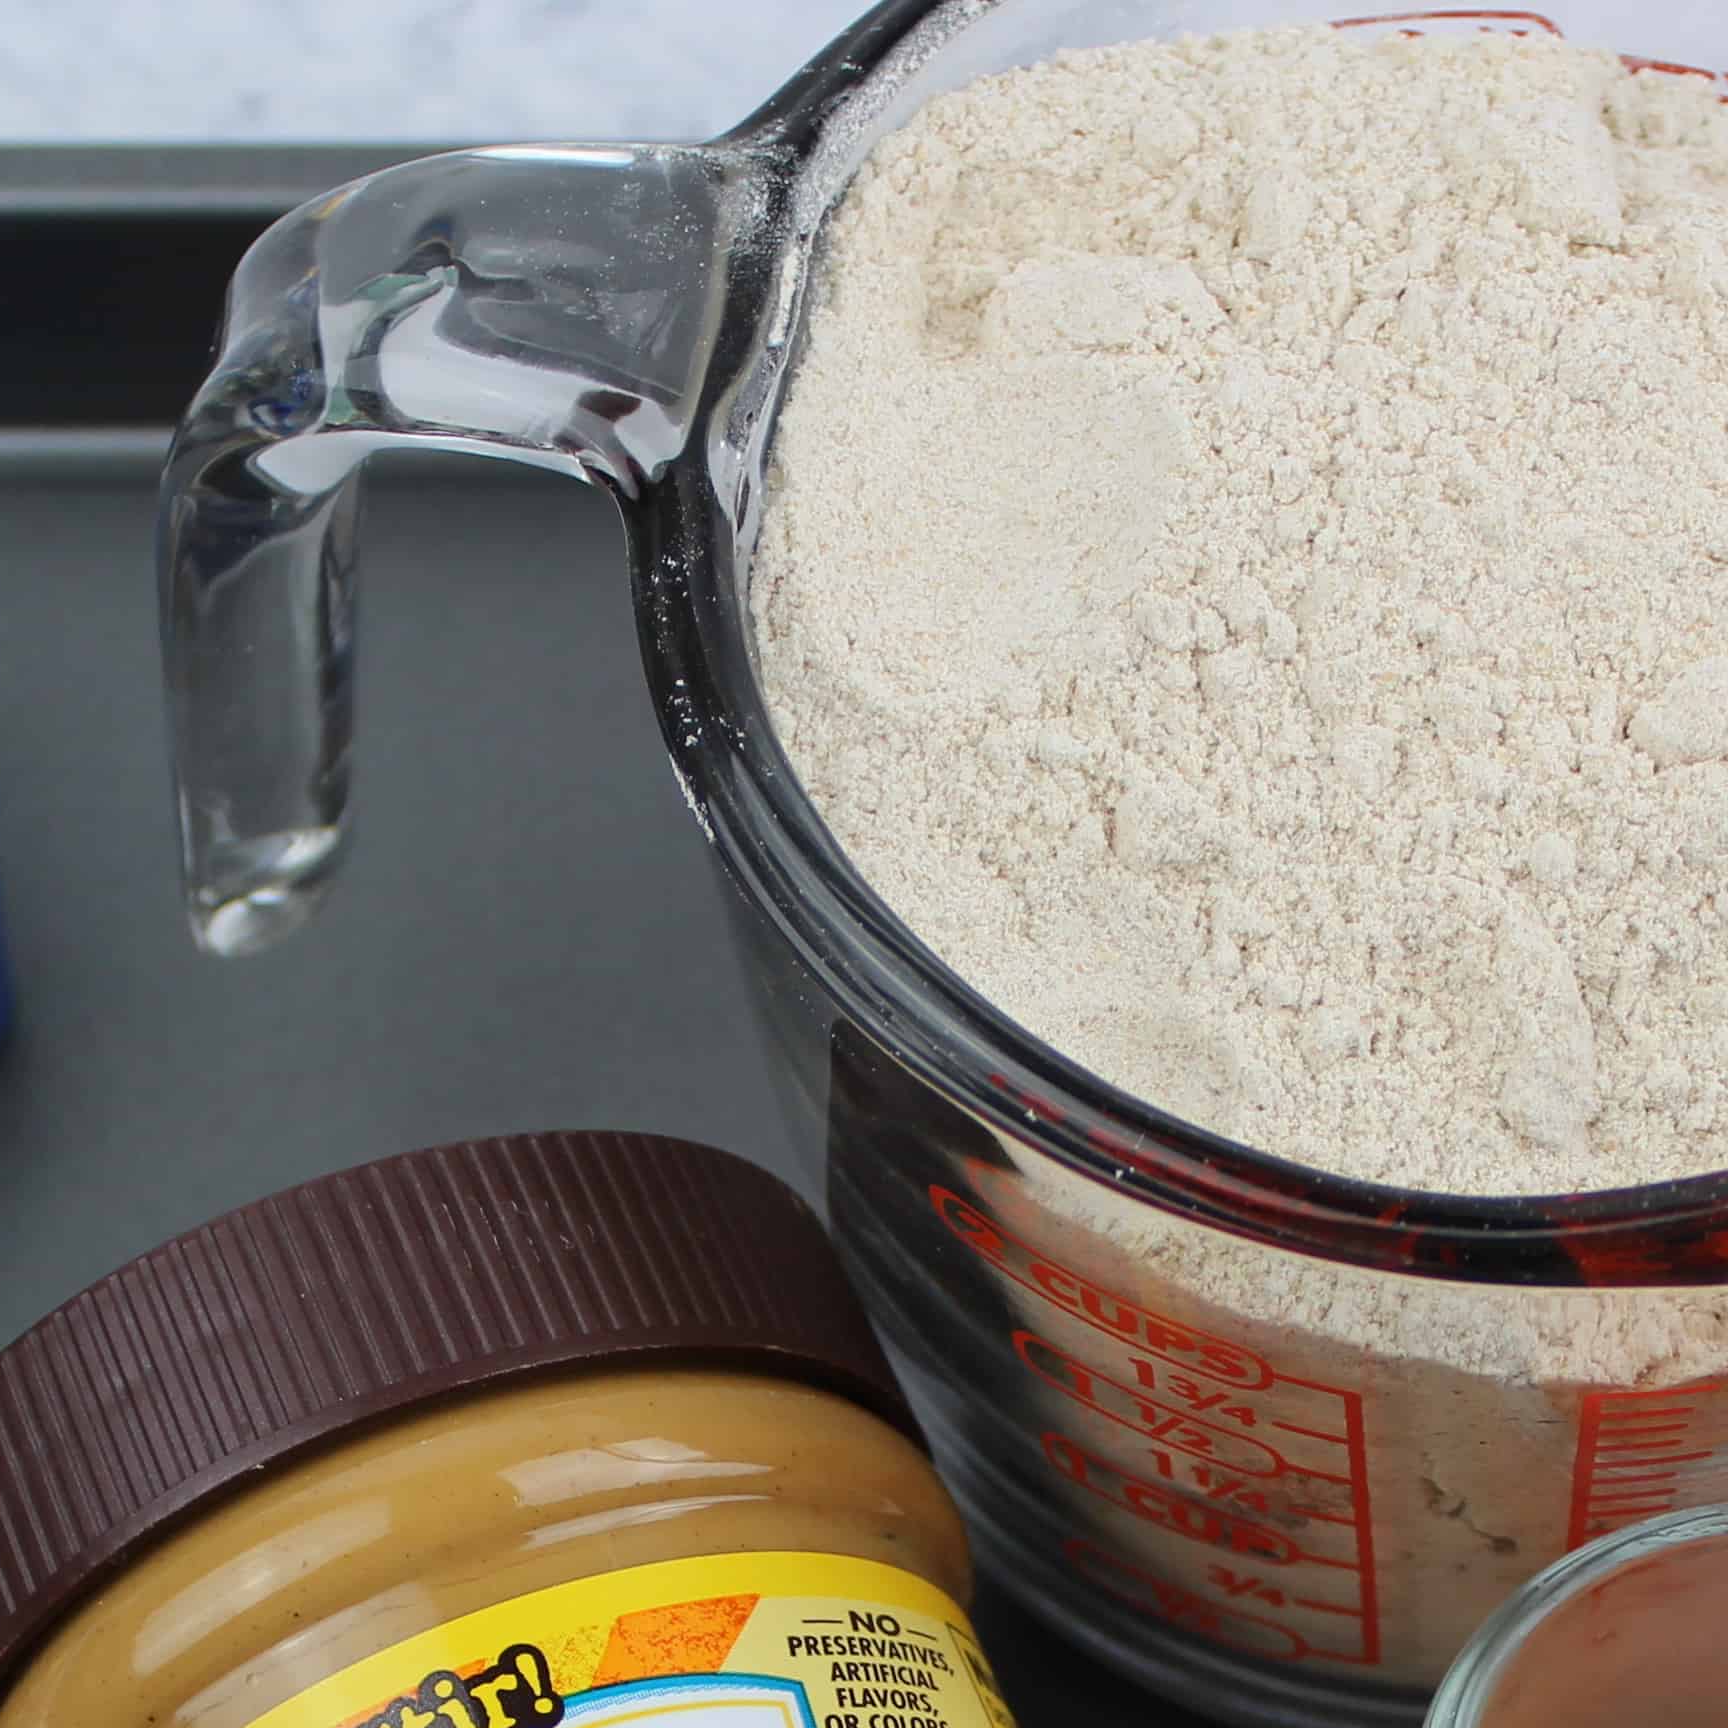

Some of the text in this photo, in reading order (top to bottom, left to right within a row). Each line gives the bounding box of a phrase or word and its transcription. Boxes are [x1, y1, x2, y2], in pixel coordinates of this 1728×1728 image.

[1029, 1263, 1250, 1379] CUPS
[1124, 1485, 1279, 1554] CUP
[847, 1610, 901, 1637] NO
[787, 1634, 954, 1677] PRESERVATIVES,
[831, 1661, 940, 1691] ARTIFICIAL
[836, 1687, 939, 1717] FLAVORS,
